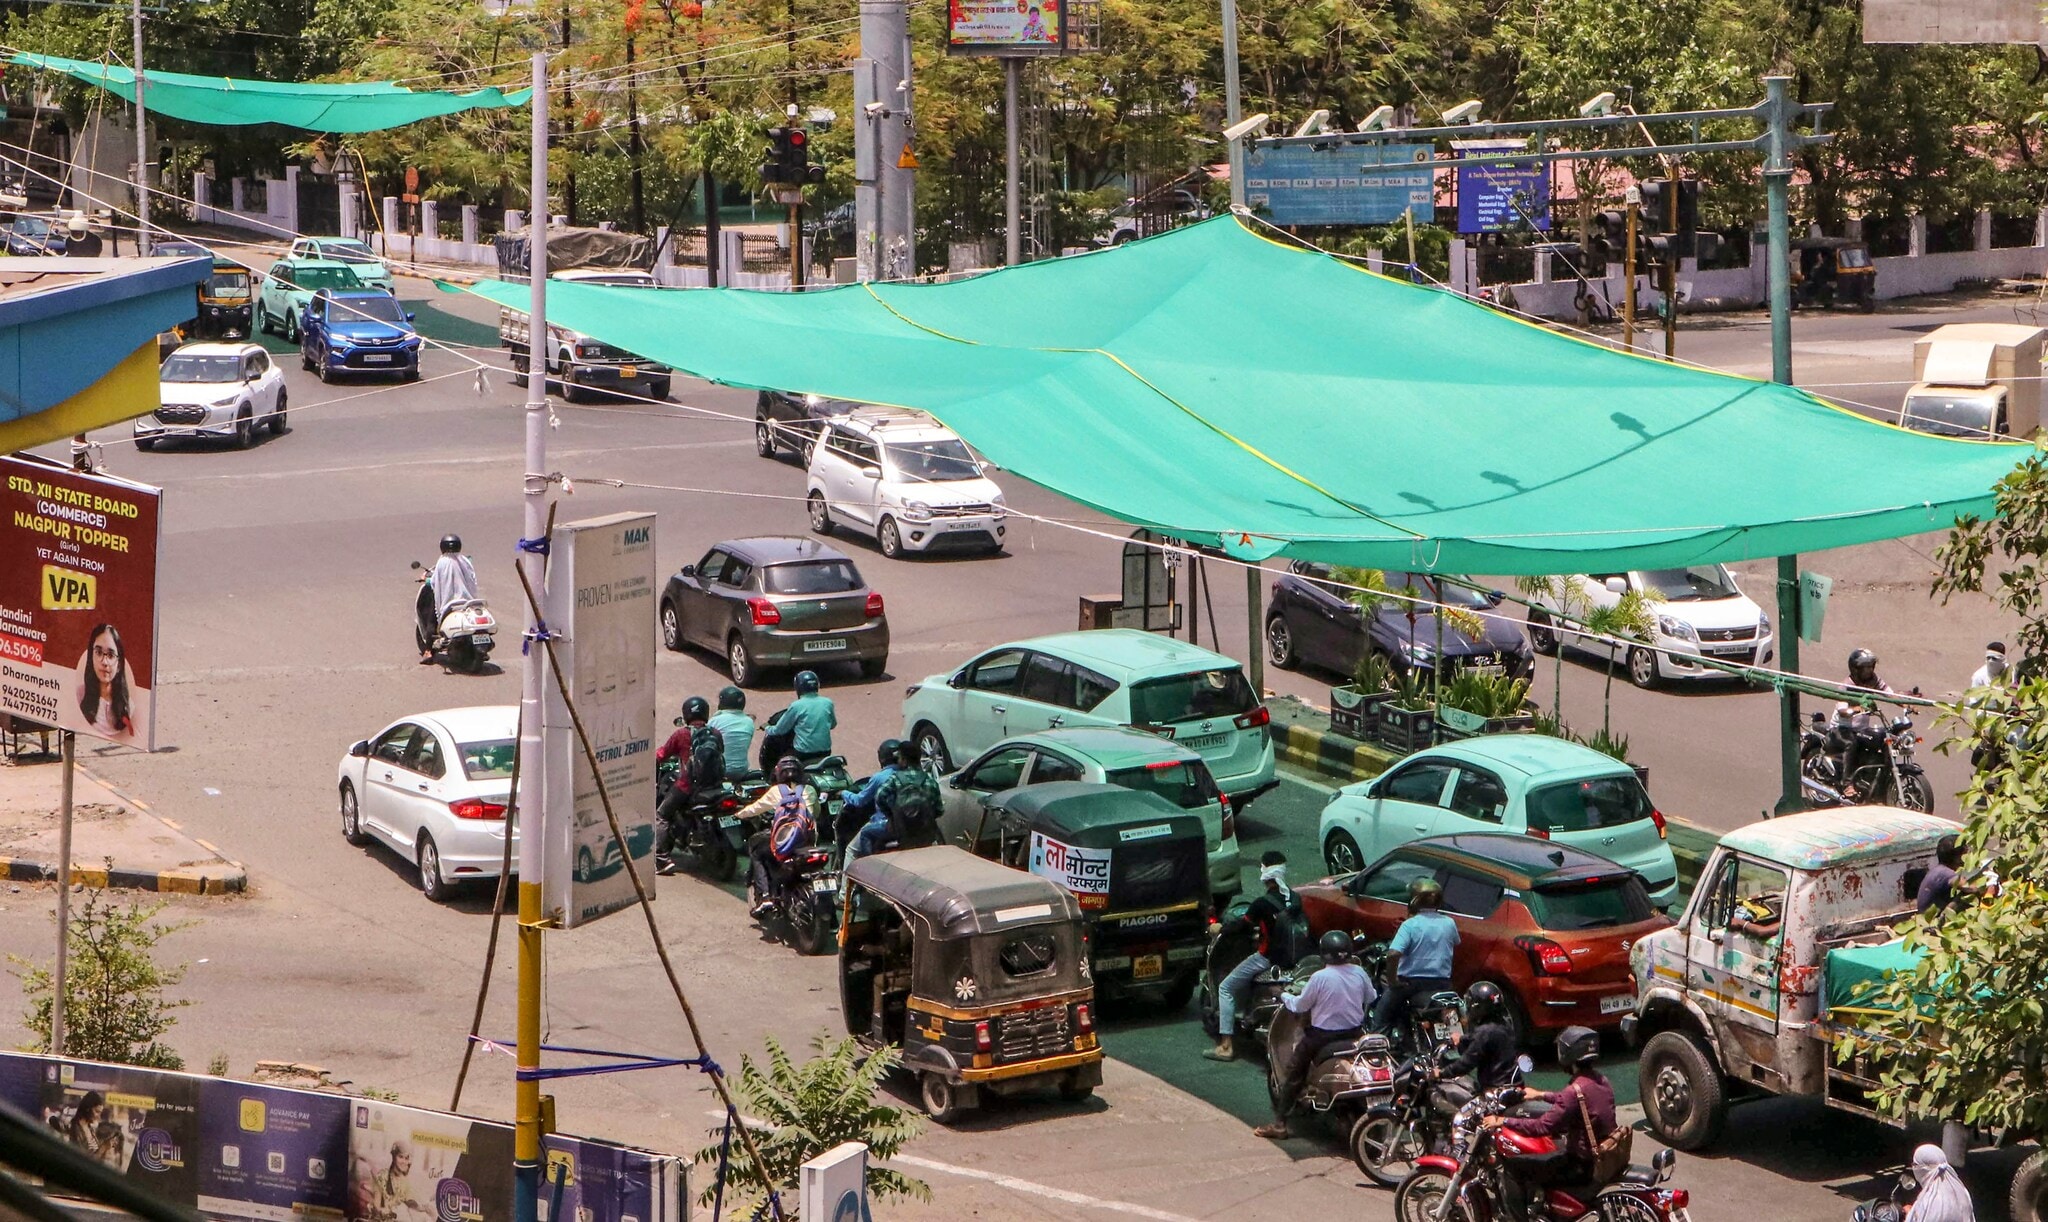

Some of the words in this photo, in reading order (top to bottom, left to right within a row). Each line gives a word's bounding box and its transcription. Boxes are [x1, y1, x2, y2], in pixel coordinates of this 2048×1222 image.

[8, 476, 34, 494] STD.
[37, 482, 52, 498] XII
[54, 487, 92, 508] STATE
[94, 498, 138, 518] BOARD
[37, 500, 107, 529] (COMMERCE)
[14, 511, 70, 540] NAGPUR
[74, 526, 129, 552] TOPPER
[624, 526, 650, 546] MAK
[60, 540, 80, 553] (Girls)
[36, 547, 52, 559] YET
[53, 552, 79, 566] AGAIN
[81, 558, 104, 572] FROM
[49, 574, 90, 604] VPA
[578, 584, 612, 608] PROVEN
[2, 666, 60, 691] Dharampeth
[2, 684, 58, 708] 9420251647
[2, 697, 58, 722] 7447799773
[596, 746, 622, 762] PETROL
[624, 739, 650, 756] ZENITH
[1067, 876, 1108, 892] परफ्यूम
[1120, 914, 1168, 928] PIAGGIO
[1623, 998, 1632, 1007] AS
[130, 1118, 144, 1130] Just
[270, 1108, 297, 1119] ADVANCE
[298, 1112, 310, 1120] PAY
[150, 1142, 181, 1162] UFill
[428, 1167, 444, 1180] Just
[448, 1194, 480, 1212] UFill
